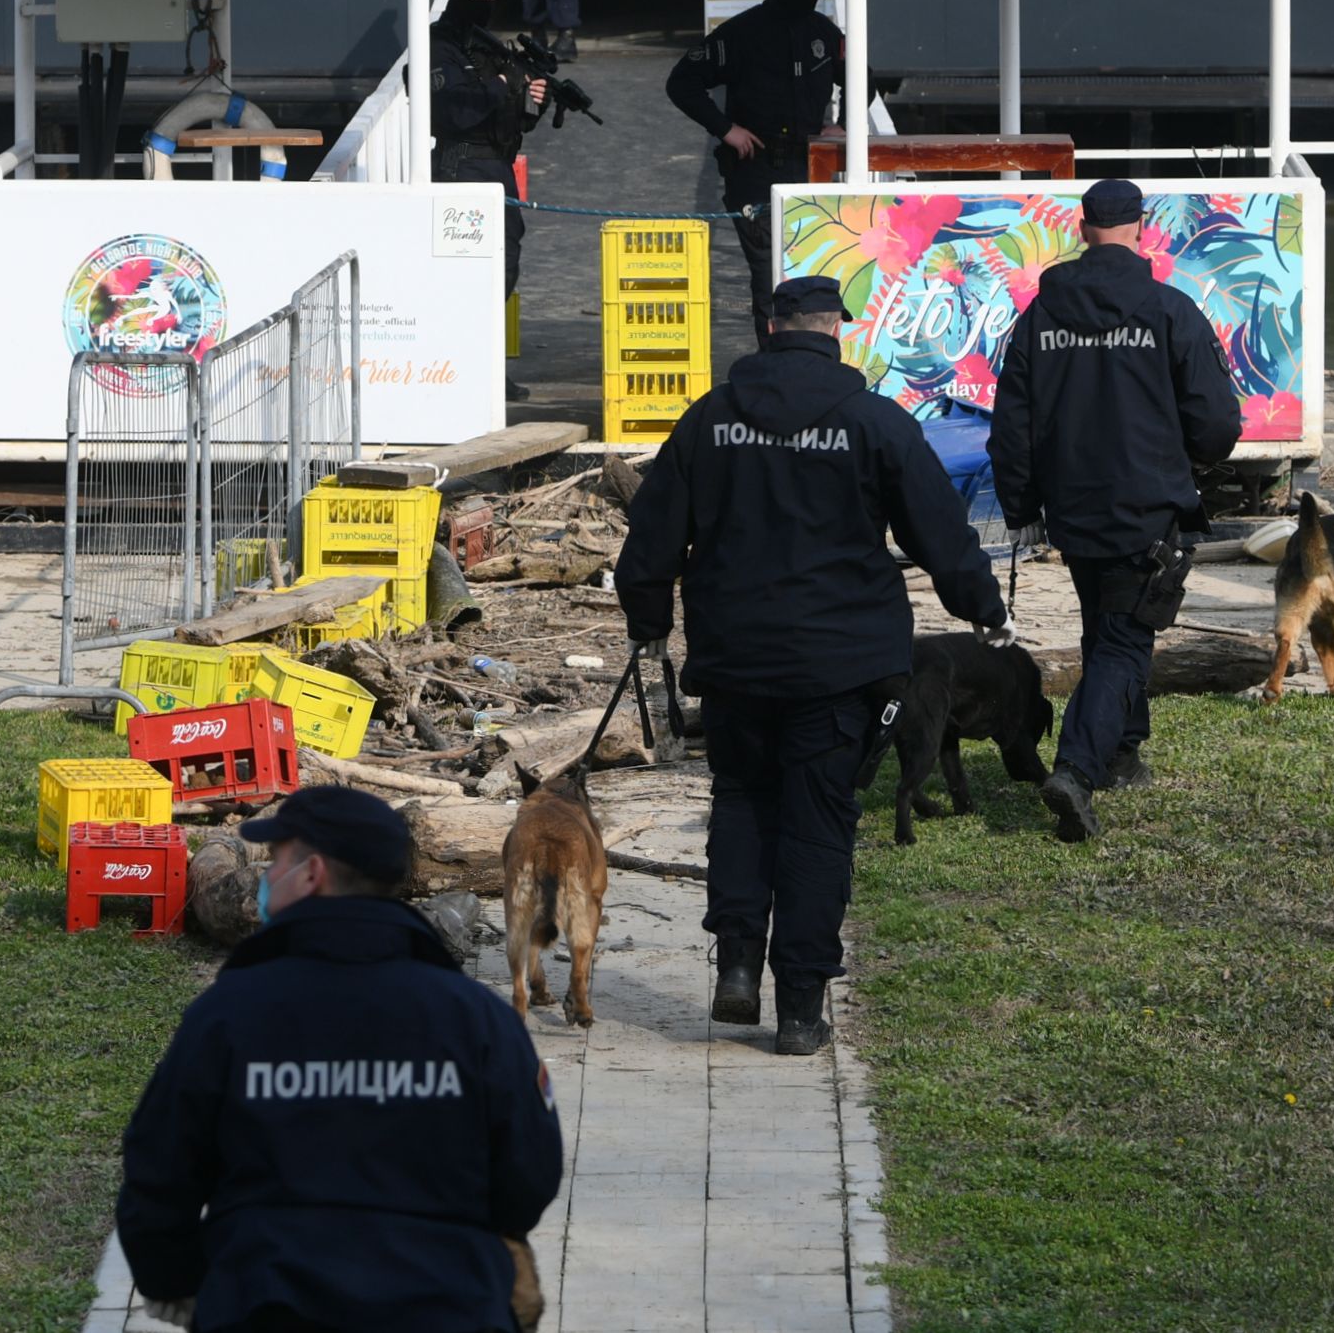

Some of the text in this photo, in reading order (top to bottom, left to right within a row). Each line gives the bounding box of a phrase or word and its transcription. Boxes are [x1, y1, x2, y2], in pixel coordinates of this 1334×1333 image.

[443, 207, 467, 225] Pet
[443, 226, 484, 244] Friendly
[90, 243, 203, 278] BELGRADE NIGHT CLUB
[99, 323, 191, 351] freestyler
[367, 358, 413, 386] river
[417, 360, 458, 384] side
[945, 378, 983, 401] day
[246, 1060, 463, 1104] ПОЛИЦИЈА
